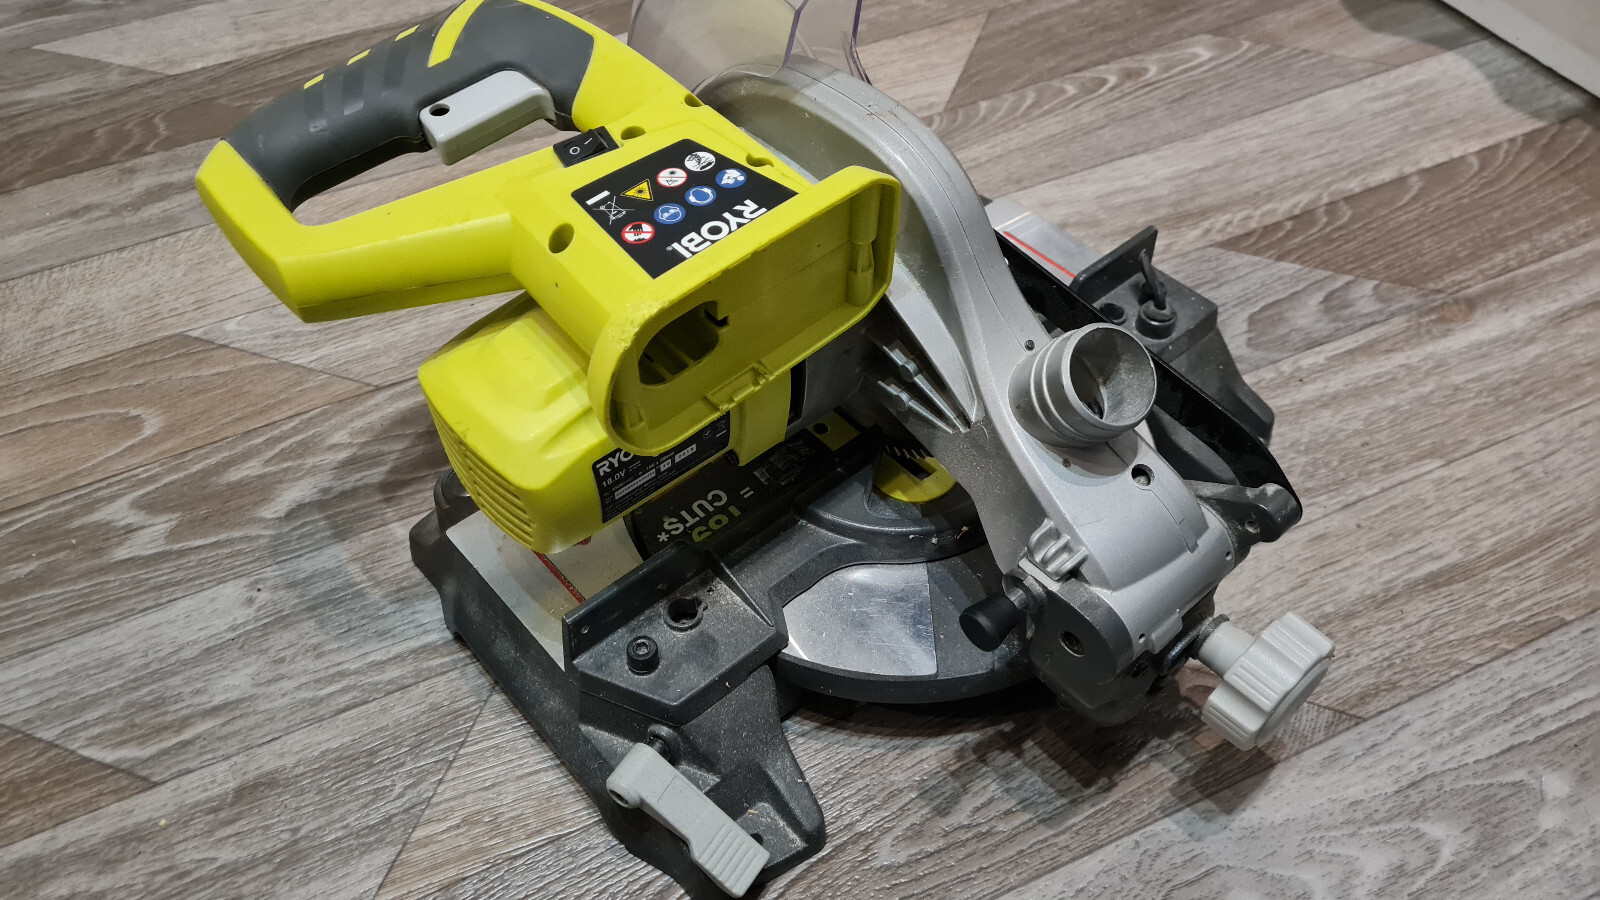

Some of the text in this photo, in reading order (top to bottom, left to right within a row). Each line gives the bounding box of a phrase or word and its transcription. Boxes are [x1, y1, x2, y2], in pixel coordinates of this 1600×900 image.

[670, 199, 768, 259] RYOBI
[596, 449, 634, 477] RYO
[601, 469, 626, 488] 18.0V
